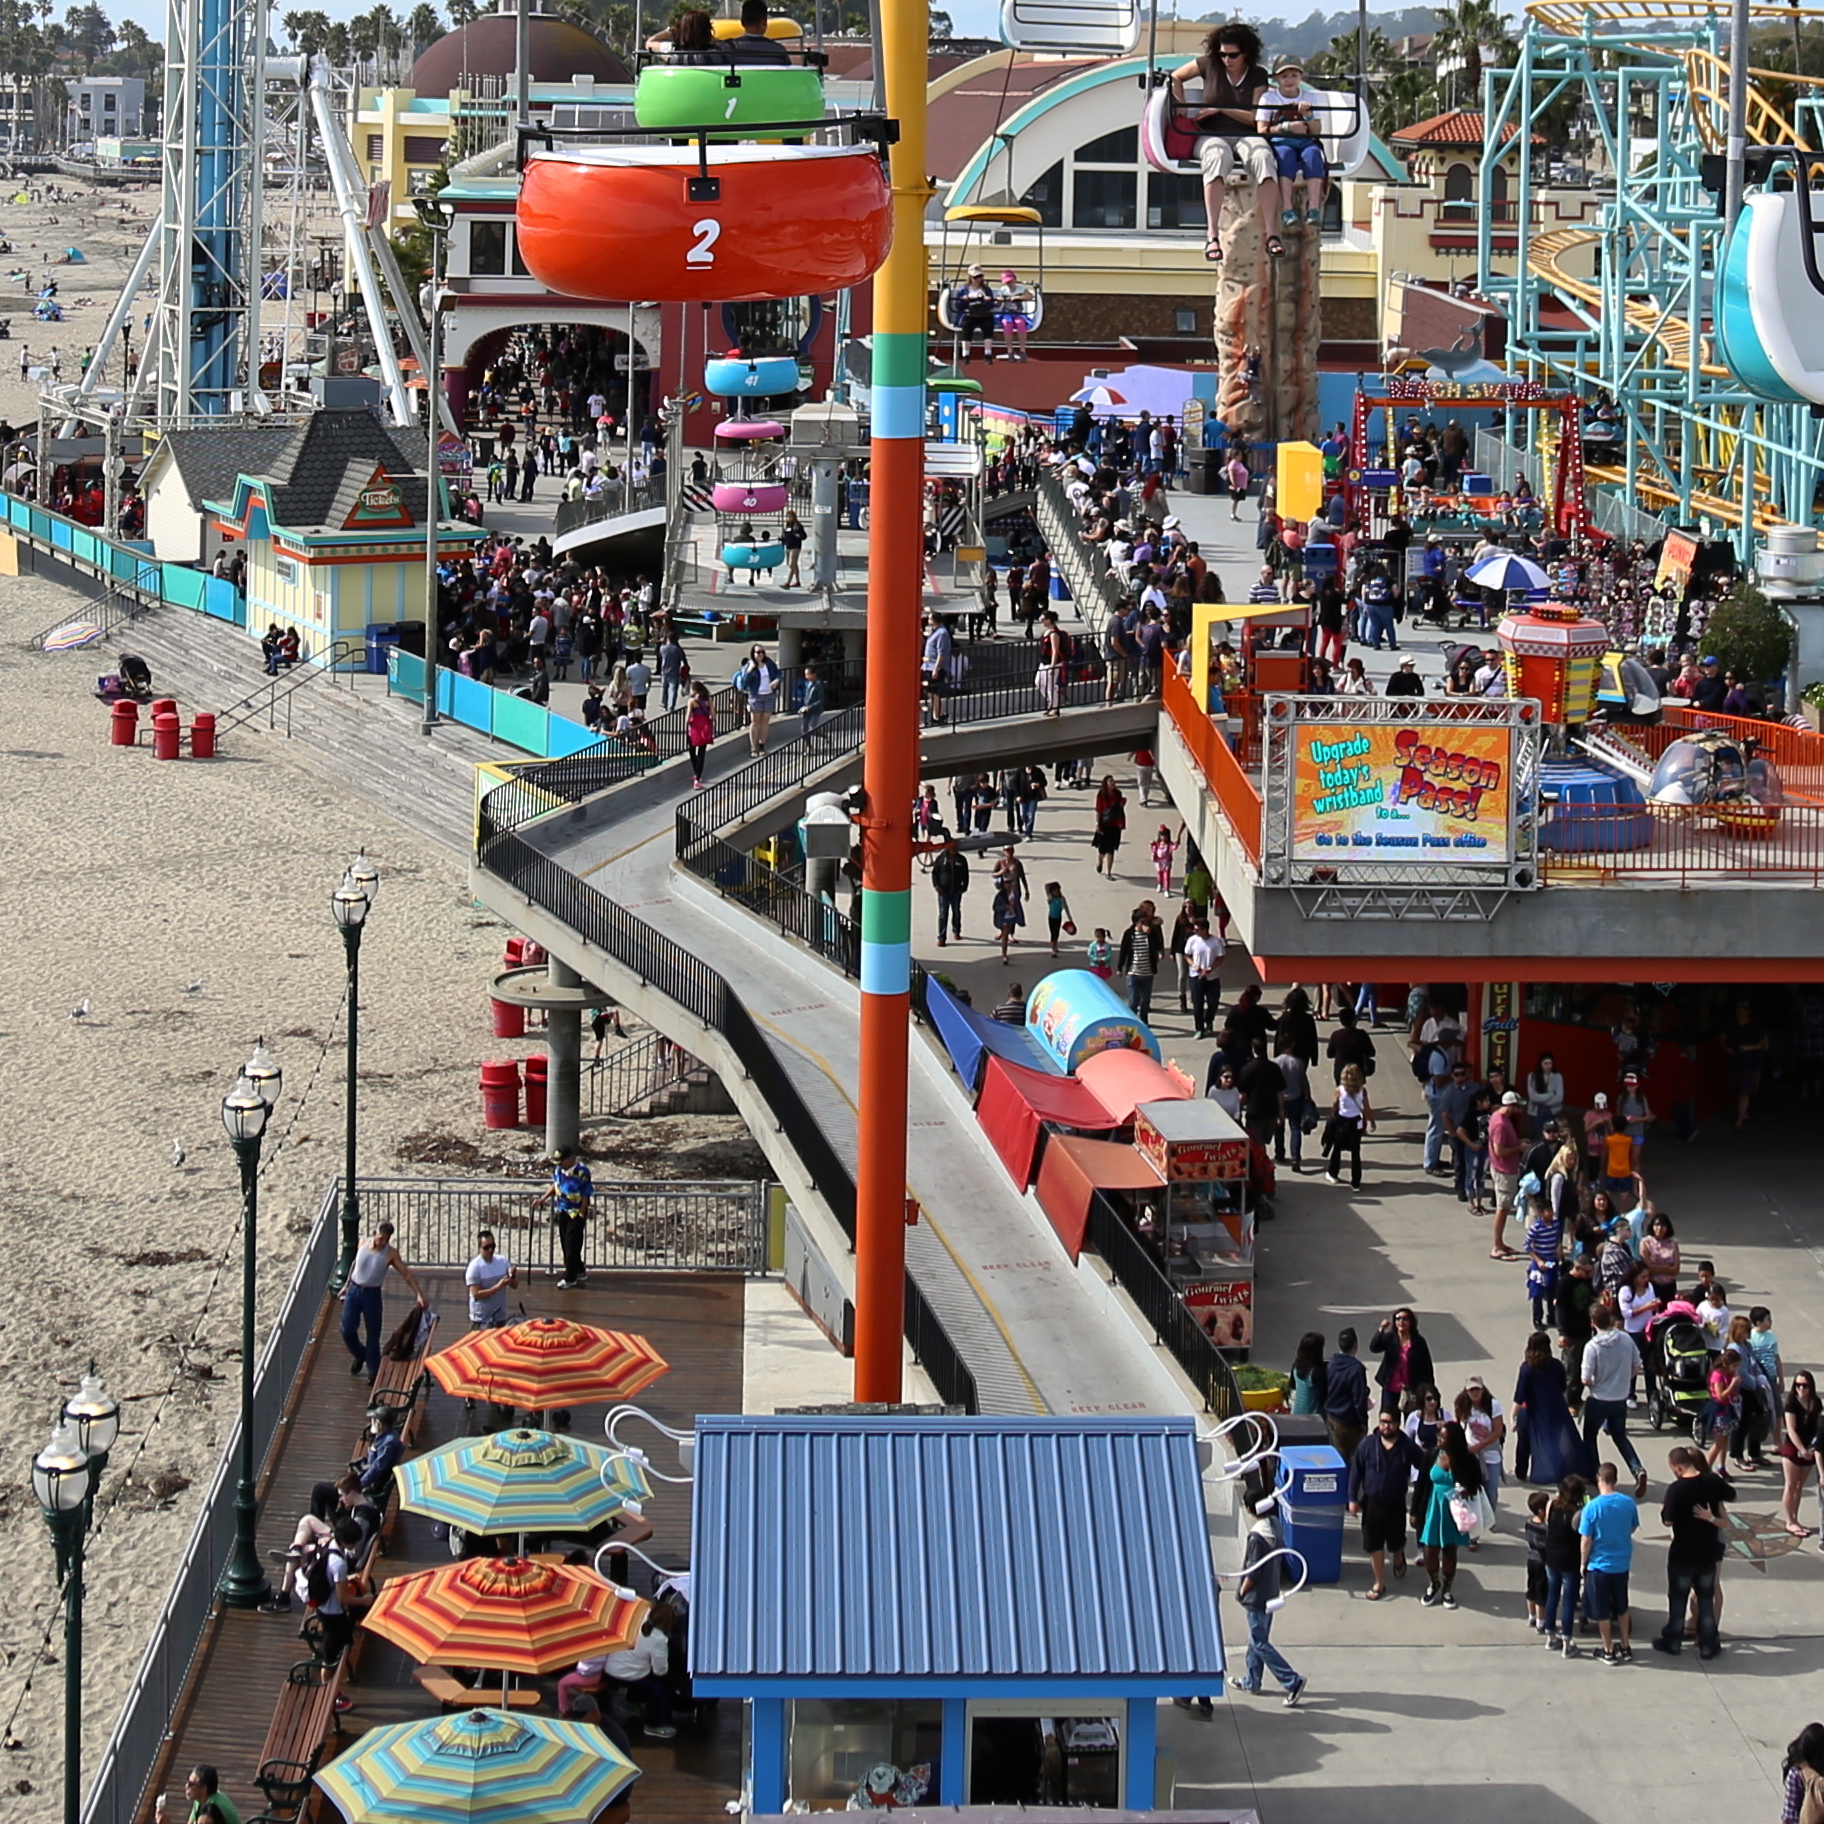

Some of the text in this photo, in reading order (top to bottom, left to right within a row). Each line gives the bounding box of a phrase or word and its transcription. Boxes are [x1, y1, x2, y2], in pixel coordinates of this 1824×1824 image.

[724, 97, 738, 120] 1
[686, 219, 721, 266] 2
[744, 375, 759, 387] 41
[1389, 380, 1462, 399] BEACH
[360, 487, 400, 506] Tickets
[742, 497, 757, 508] 40
[1310, 732, 1371, 767] Upgrade
[1394, 729, 1501, 791] Season
[1319, 760, 1370, 790] today's
[1312, 779, 1383, 814] wristband
[1397, 766, 1483, 821] Pass!
[1315, 832, 1333, 847] Go
[1336, 832, 1348, 847] to
[1352, 832, 1372, 847] the
[1375, 832, 1419, 847] Season
[1422, 832, 1450, 847] Pass
[1494, 984, 1509, 1017] urf
[1177, 1142, 1223, 1155] Gourmet
[1185, 1283, 1233, 1297] Gourmet
[1213, 1289, 1250, 1305] Twists
